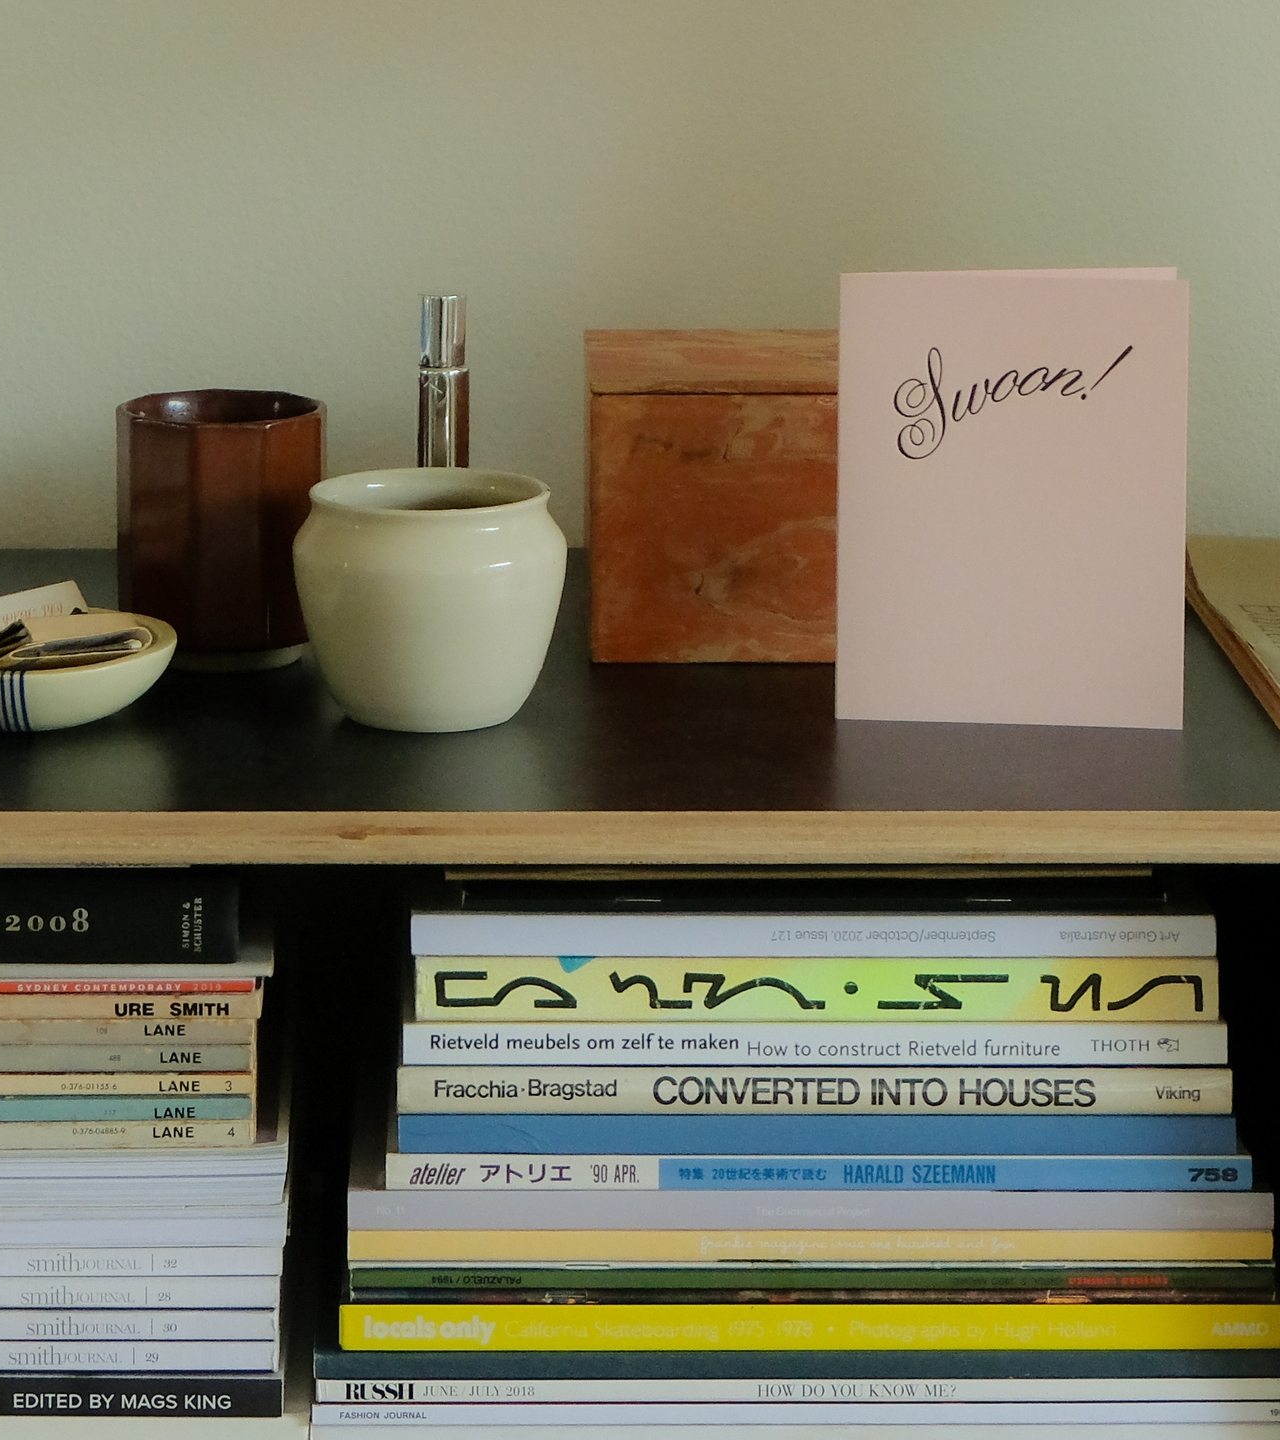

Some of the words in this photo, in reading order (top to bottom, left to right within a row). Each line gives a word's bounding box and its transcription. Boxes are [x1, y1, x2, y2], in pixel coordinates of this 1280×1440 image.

[892, 344, 1134, 461] Swoon!
[193, 896, 203, 953] SCHUSTER
[794, 930, 826, 942] Issue
[865, 929, 997, 944] September/October
[1058, 930, 1118, 941] Australia
[1120, 929, 1157, 942] Guide
[16, 983, 69, 992] SYDNEY
[74, 982, 182, 992] CONTEMPORARY
[114, 1002, 155, 1017] URE
[169, 1002, 230, 1017] SMITH
[143, 1023, 187, 1037] LANE
[429, 1032, 499, 1051] Rietveld
[506, 1032, 581, 1051] meubels
[586, 1038, 615, 1051] om
[621, 1032, 655, 1051] zelf
[657, 1035, 675, 1050] te
[680, 1032, 740, 1051] maken
[746, 1040, 786, 1058] How
[793, 1041, 813, 1058] to
[817, 1040, 903, 1058] construct
[908, 1038, 978, 1058] Rietveld
[983, 1038, 1061, 1057] furniture
[1090, 1038, 1150, 1053] THOTH
[159, 1051, 202, 1065] LANE
[158, 1080, 201, 1093] LANE
[224, 1080, 233, 1092] 3
[652, 1076, 861, 1108] CONVERTED
[870, 1077, 949, 1107] INTO
[958, 1077, 1097, 1108] HOUSES
[1154, 1085, 1201, 1103] Viking
[153, 1106, 196, 1119] LANE
[152, 1126, 195, 1139] LANE
[227, 1126, 235, 1138] 4
[409, 1163, 467, 1186] atelier
[479, 1163, 573, 1184] アトリエ
[614, 1164, 641, 1185] APR.
[677, 1166, 705, 1182] 特集
[843, 1164, 905, 1185] HARALD
[912, 1164, 997, 1185] SZEEMANN
[1187, 1167, 1239, 1184] 758
[699, 1236, 754, 1256] frankie
[759, 1239, 826, 1256] magazine
[897, 1236, 952, 1250] hundred
[462, 1275, 523, 1285] PALAZUELO
[363, 1314, 436, 1339] locals
[440, 1315, 497, 1346] only
[505, 1319, 589, 1339] California
[594, 1319, 719, 1343] Skateboarding
[728, 1320, 765, 1339] 1975
[777, 1320, 814, 1338] 1978
[849, 1319, 961, 1344] Photographs
[967, 1320, 986, 1343] by
[993, 1320, 1041, 1344] Hugh
[1047, 1320, 1118, 1339] Holland
[1210, 1322, 1269, 1337] AMMO
[344, 1382, 416, 1401] RUSSH
[422, 1383, 459, 1398] JUNE
[468, 1383, 503, 1398] JULY
[505, 1384, 536, 1398] 2018
[756, 1383, 797, 1399] HOW
[800, 1383, 826, 1398] DO
[830, 1383, 864, 1398] YOU
[868, 1383, 919, 1398] KNOW
[923, 1383, 958, 1399] ME?
[12, 1392, 83, 1410] EDITED
[88, 1393, 115, 1411] BY
[120, 1393, 179, 1411] MAGS
[183, 1393, 233, 1411] KING
[339, 1410, 380, 1420] FASHION
[383, 1410, 427, 1420] JOURNAL
